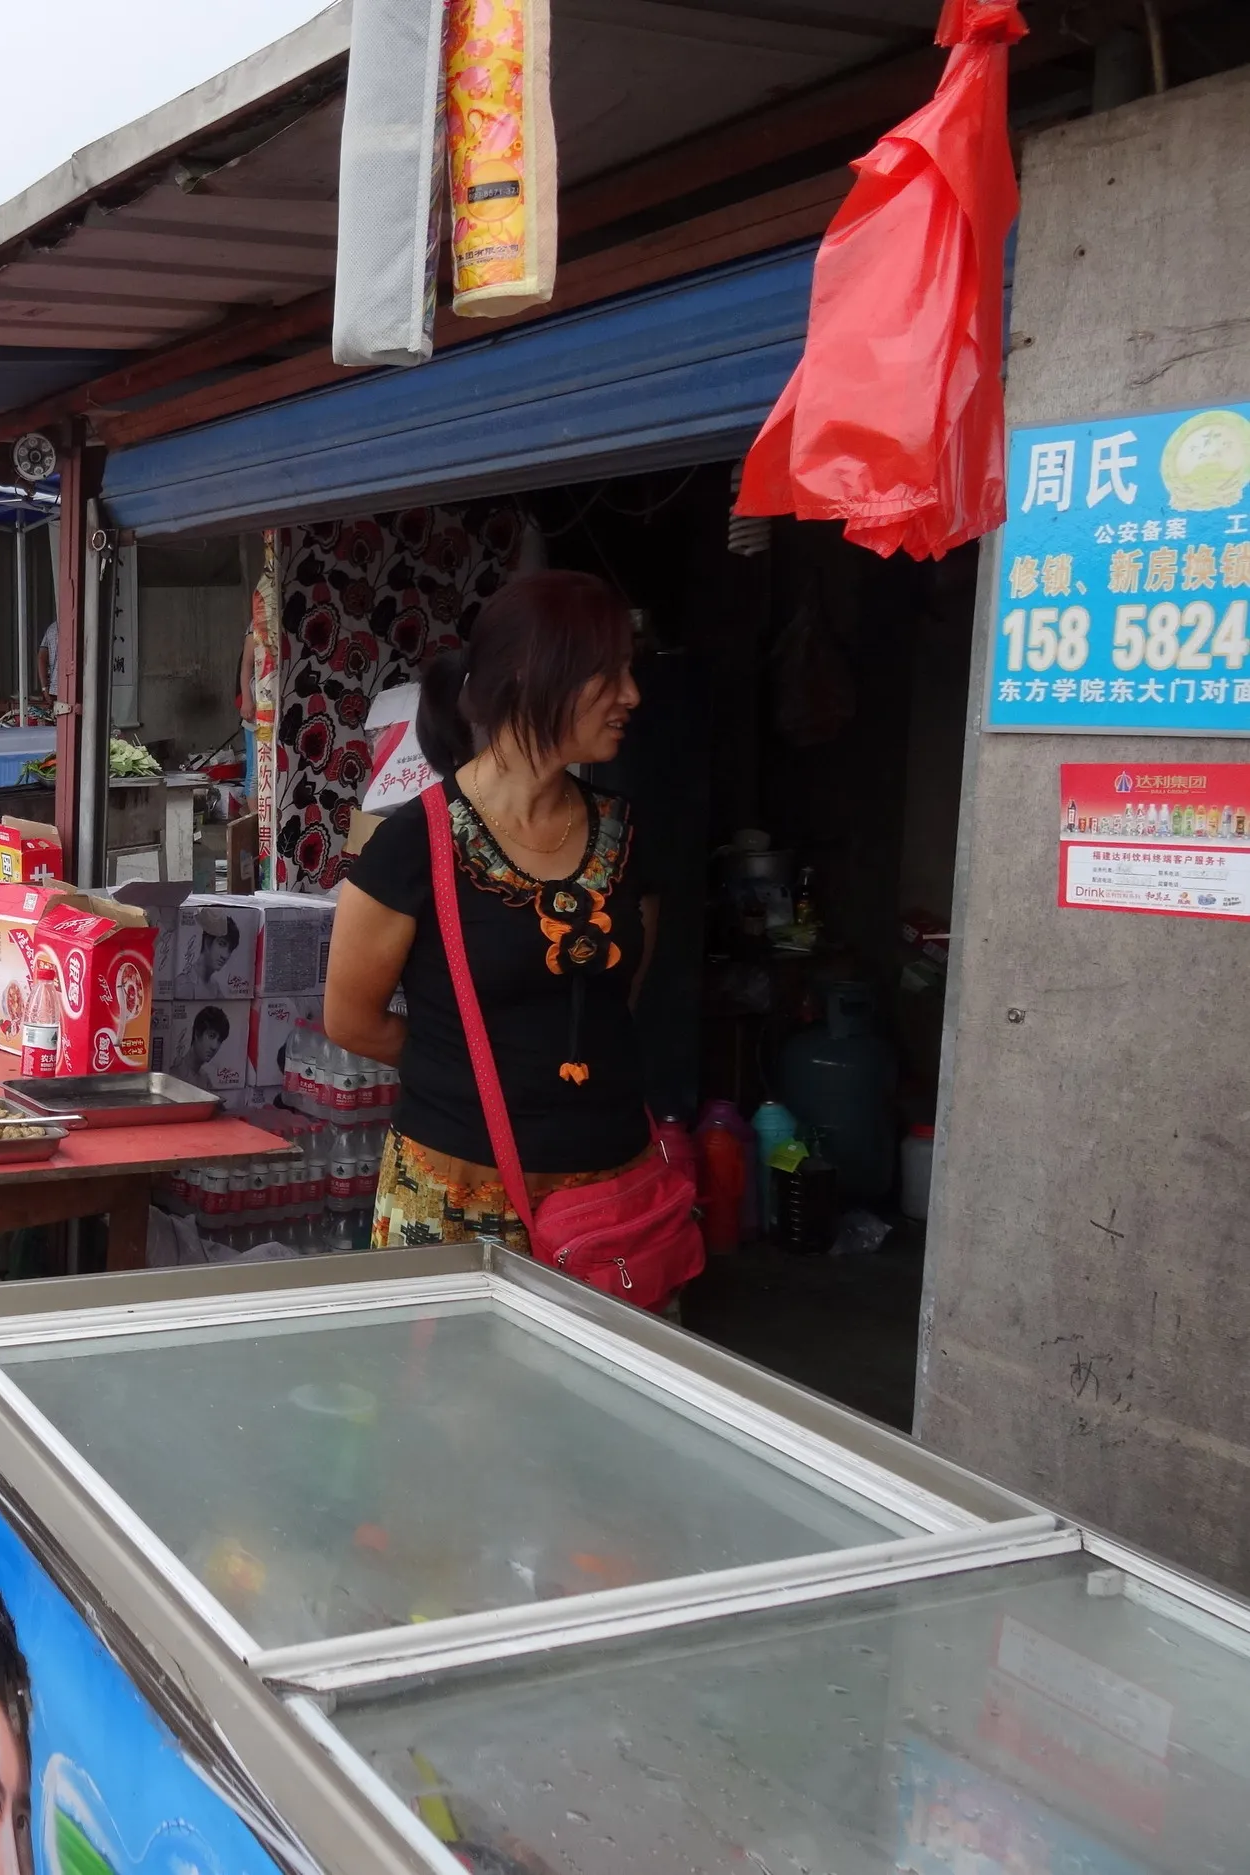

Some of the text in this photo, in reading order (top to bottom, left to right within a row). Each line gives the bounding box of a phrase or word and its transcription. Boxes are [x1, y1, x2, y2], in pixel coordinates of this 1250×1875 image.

[1021, 430, 1139, 513] 周氏
[1094, 518, 1188, 544] 公安备案
[1003, 600, 1250, 672] 158 5824
[998, 678, 1250, 704] 东方学院东大门对面
[1135, 774, 1207, 788] 达利集团
[1093, 850, 1226, 867] 福建达利饮料终端客户服务卡
[1075, 886, 1104, 898] Drink
